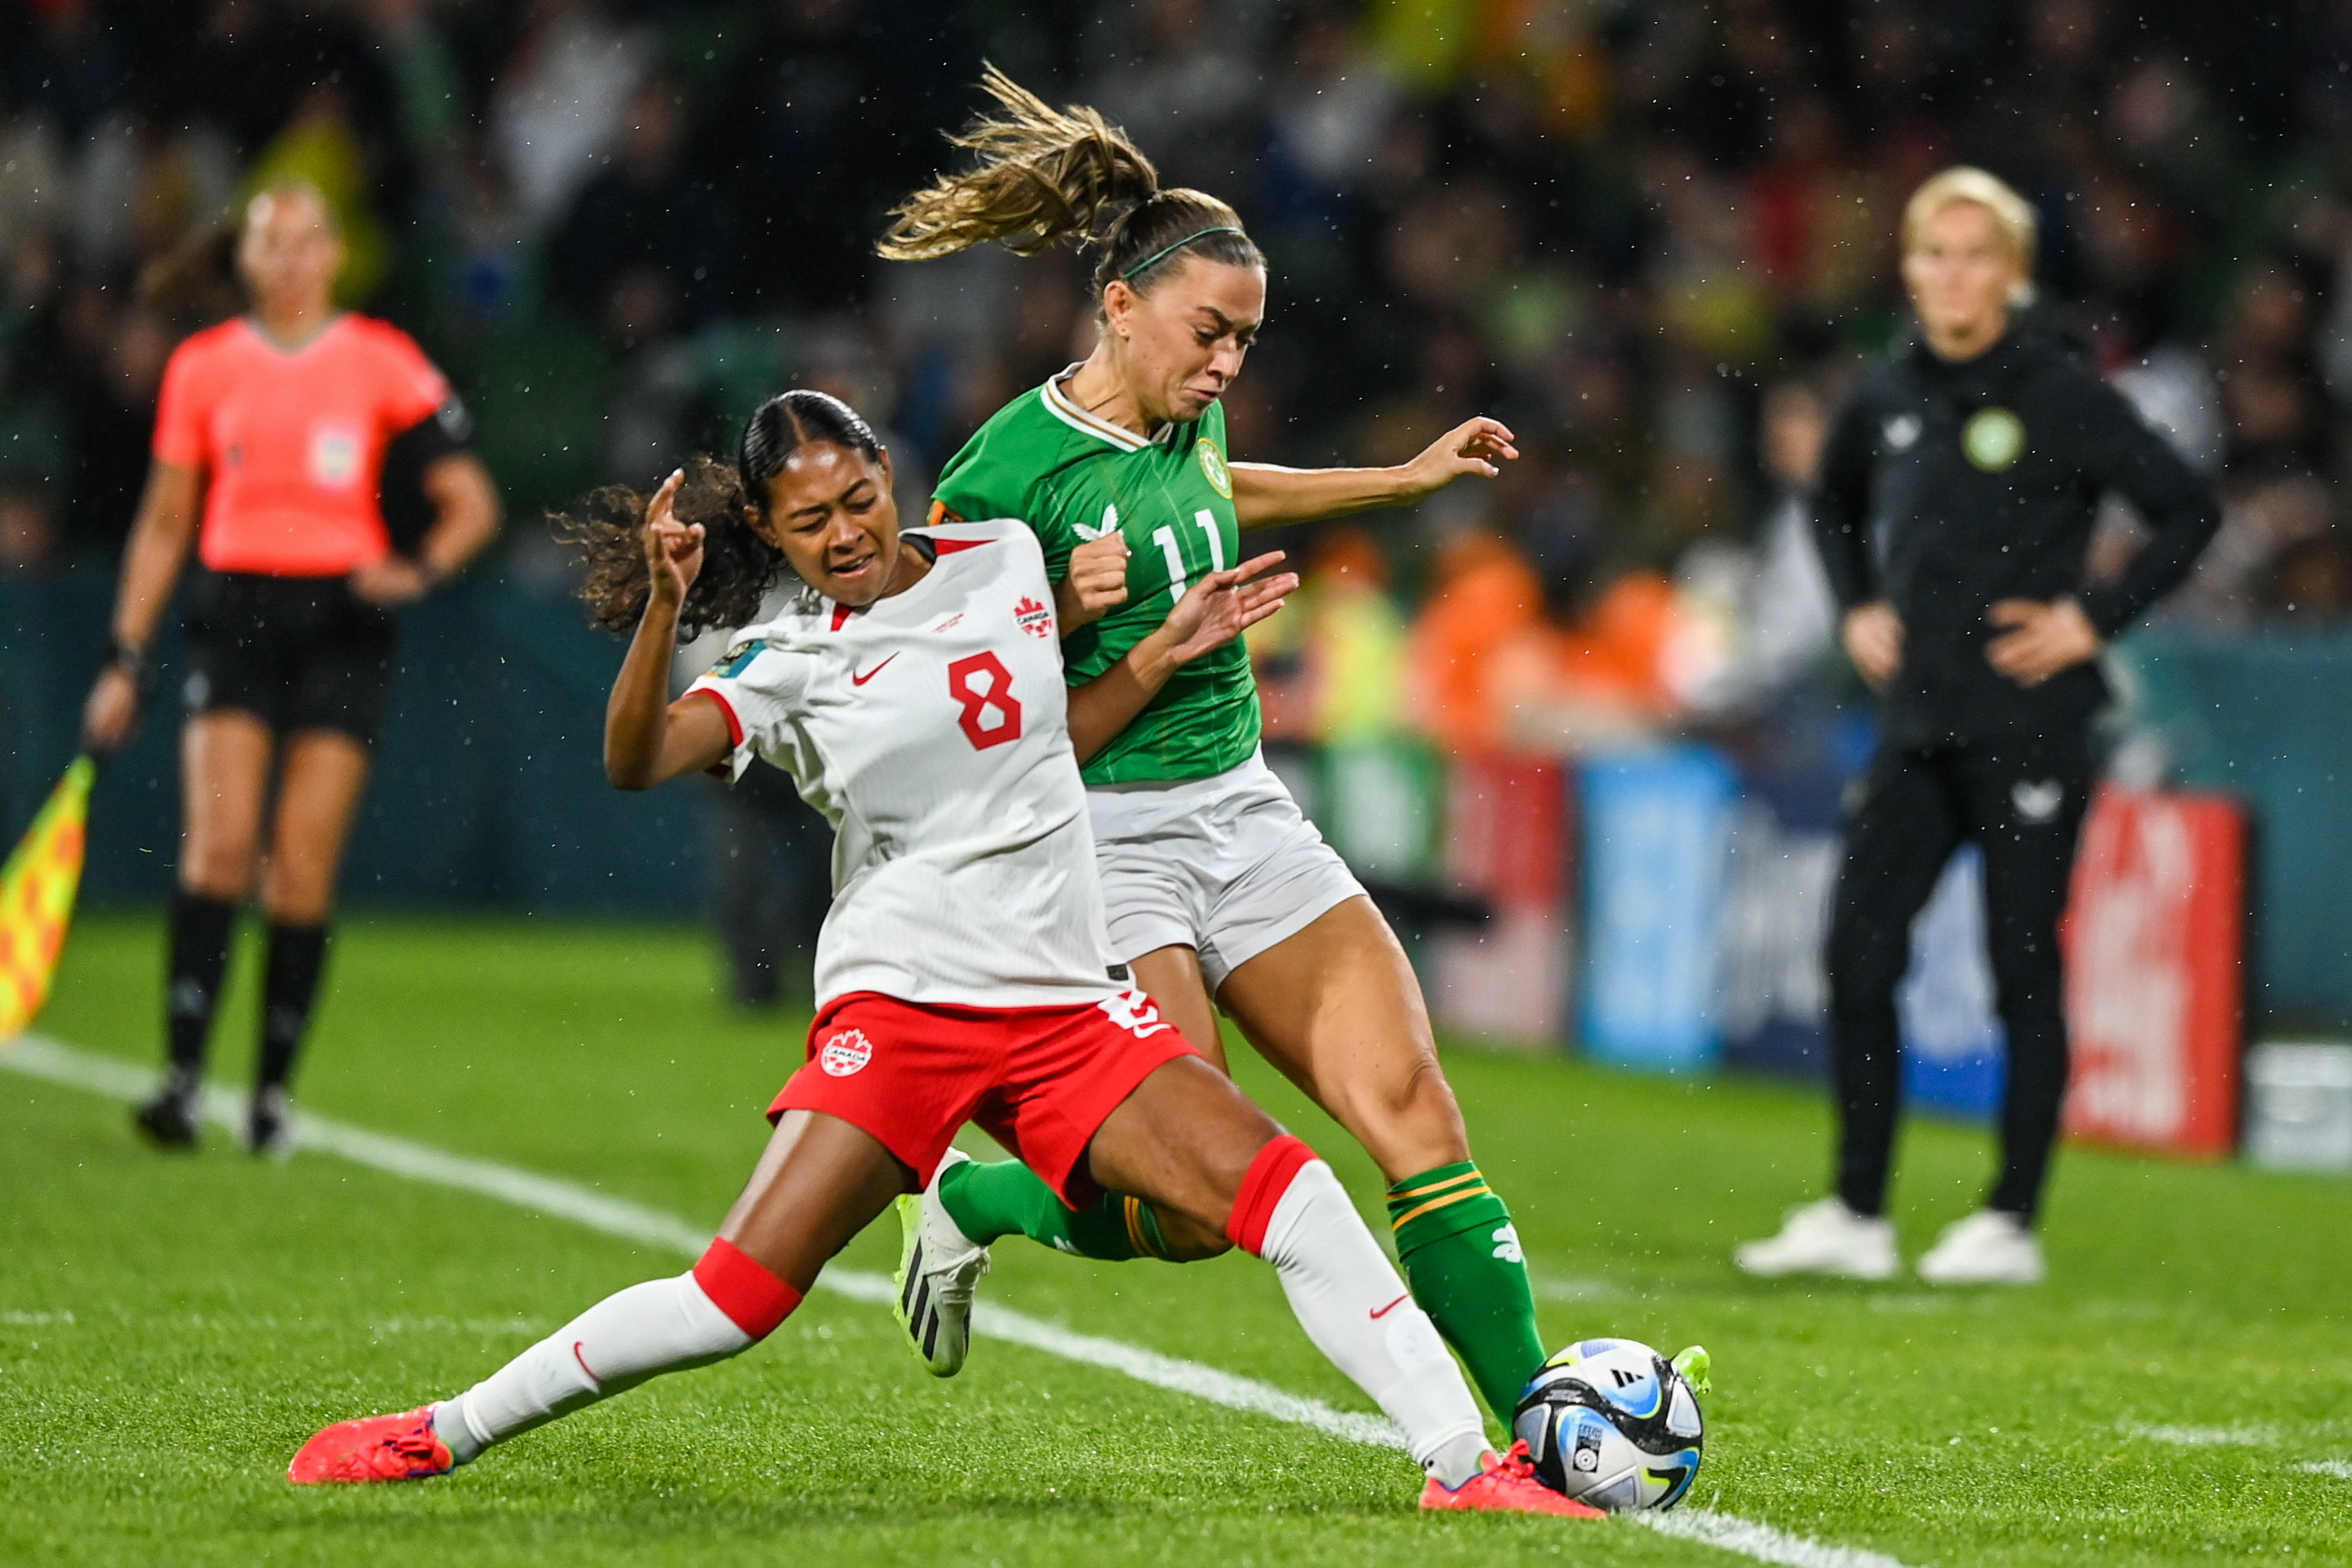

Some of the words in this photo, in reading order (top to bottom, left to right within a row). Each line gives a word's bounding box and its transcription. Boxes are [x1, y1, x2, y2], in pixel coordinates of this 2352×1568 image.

[1152, 508, 1224, 605] 11
[1016, 611, 1050, 625] CANADA
[949, 651, 1021, 750] 8
